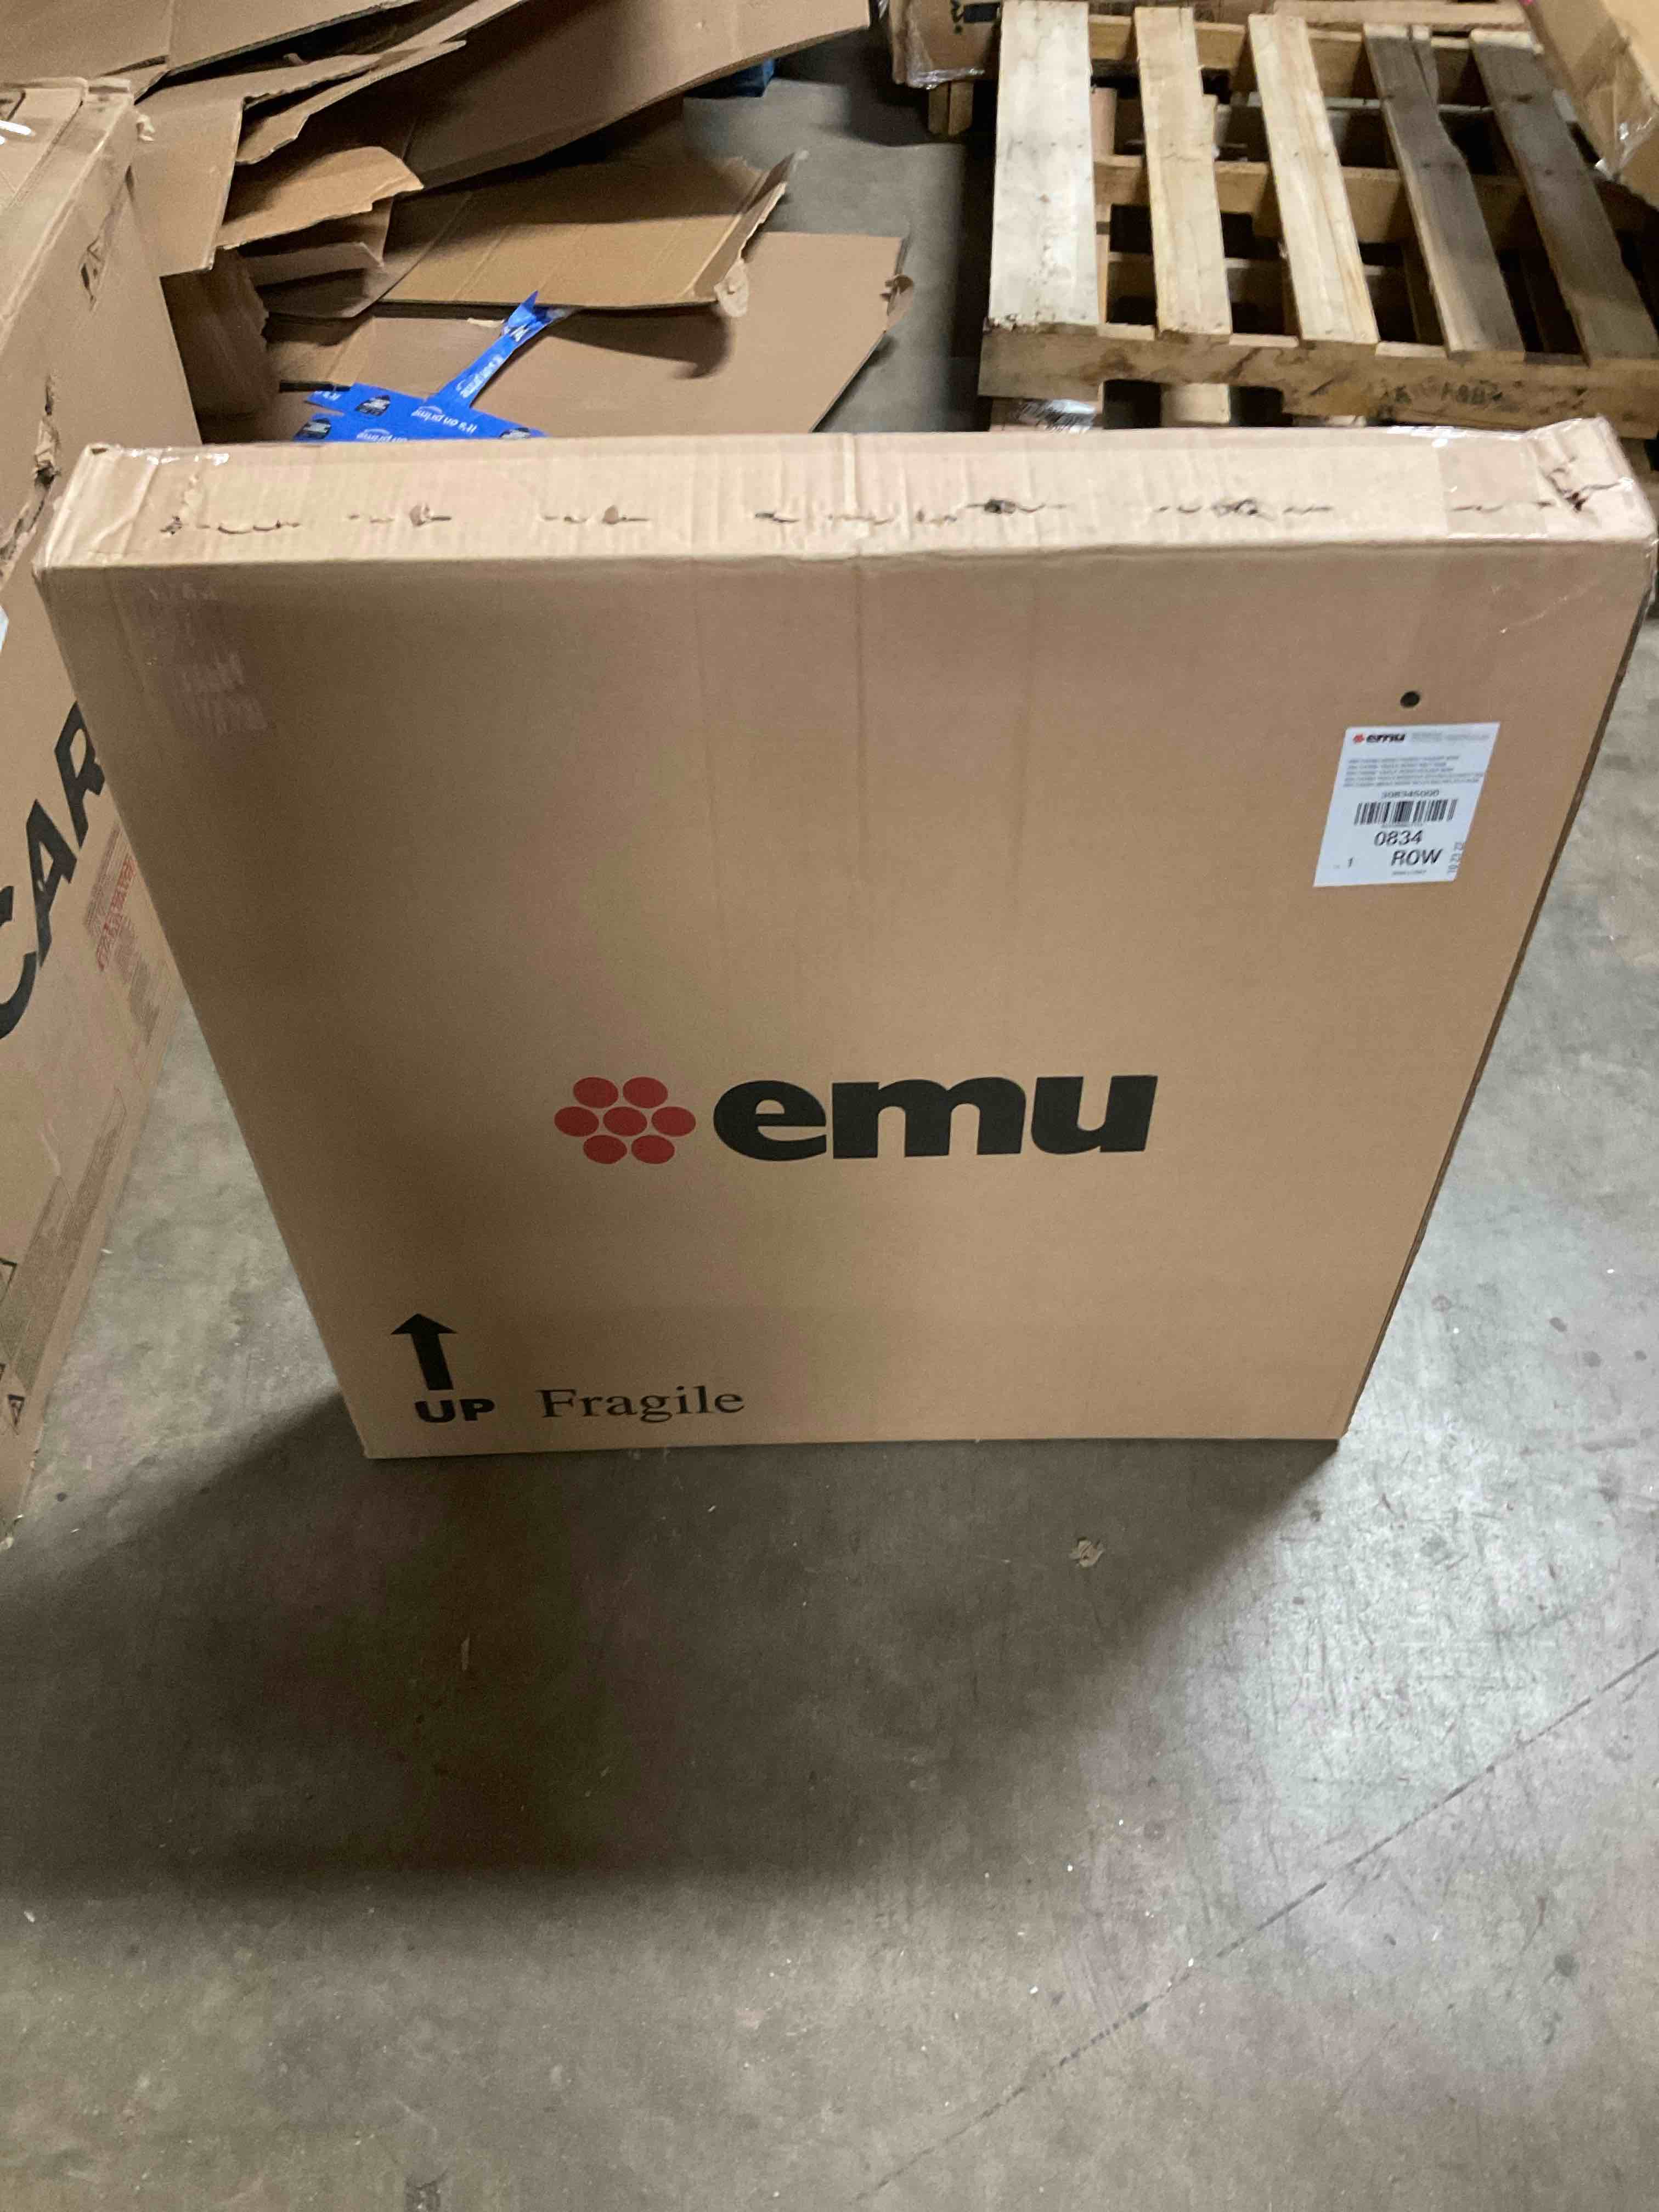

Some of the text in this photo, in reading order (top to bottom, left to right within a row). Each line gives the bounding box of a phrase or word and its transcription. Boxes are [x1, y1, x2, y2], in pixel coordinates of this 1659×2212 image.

[1367, 733, 1406, 742] emu
[1374, 830, 1423, 847] 0834
[1391, 849, 1443, 867] ROW
[714, 1075, 1158, 1161] emu
[414, 1398, 495, 1423] UP
[535, 1385, 745, 1423] Fragile
